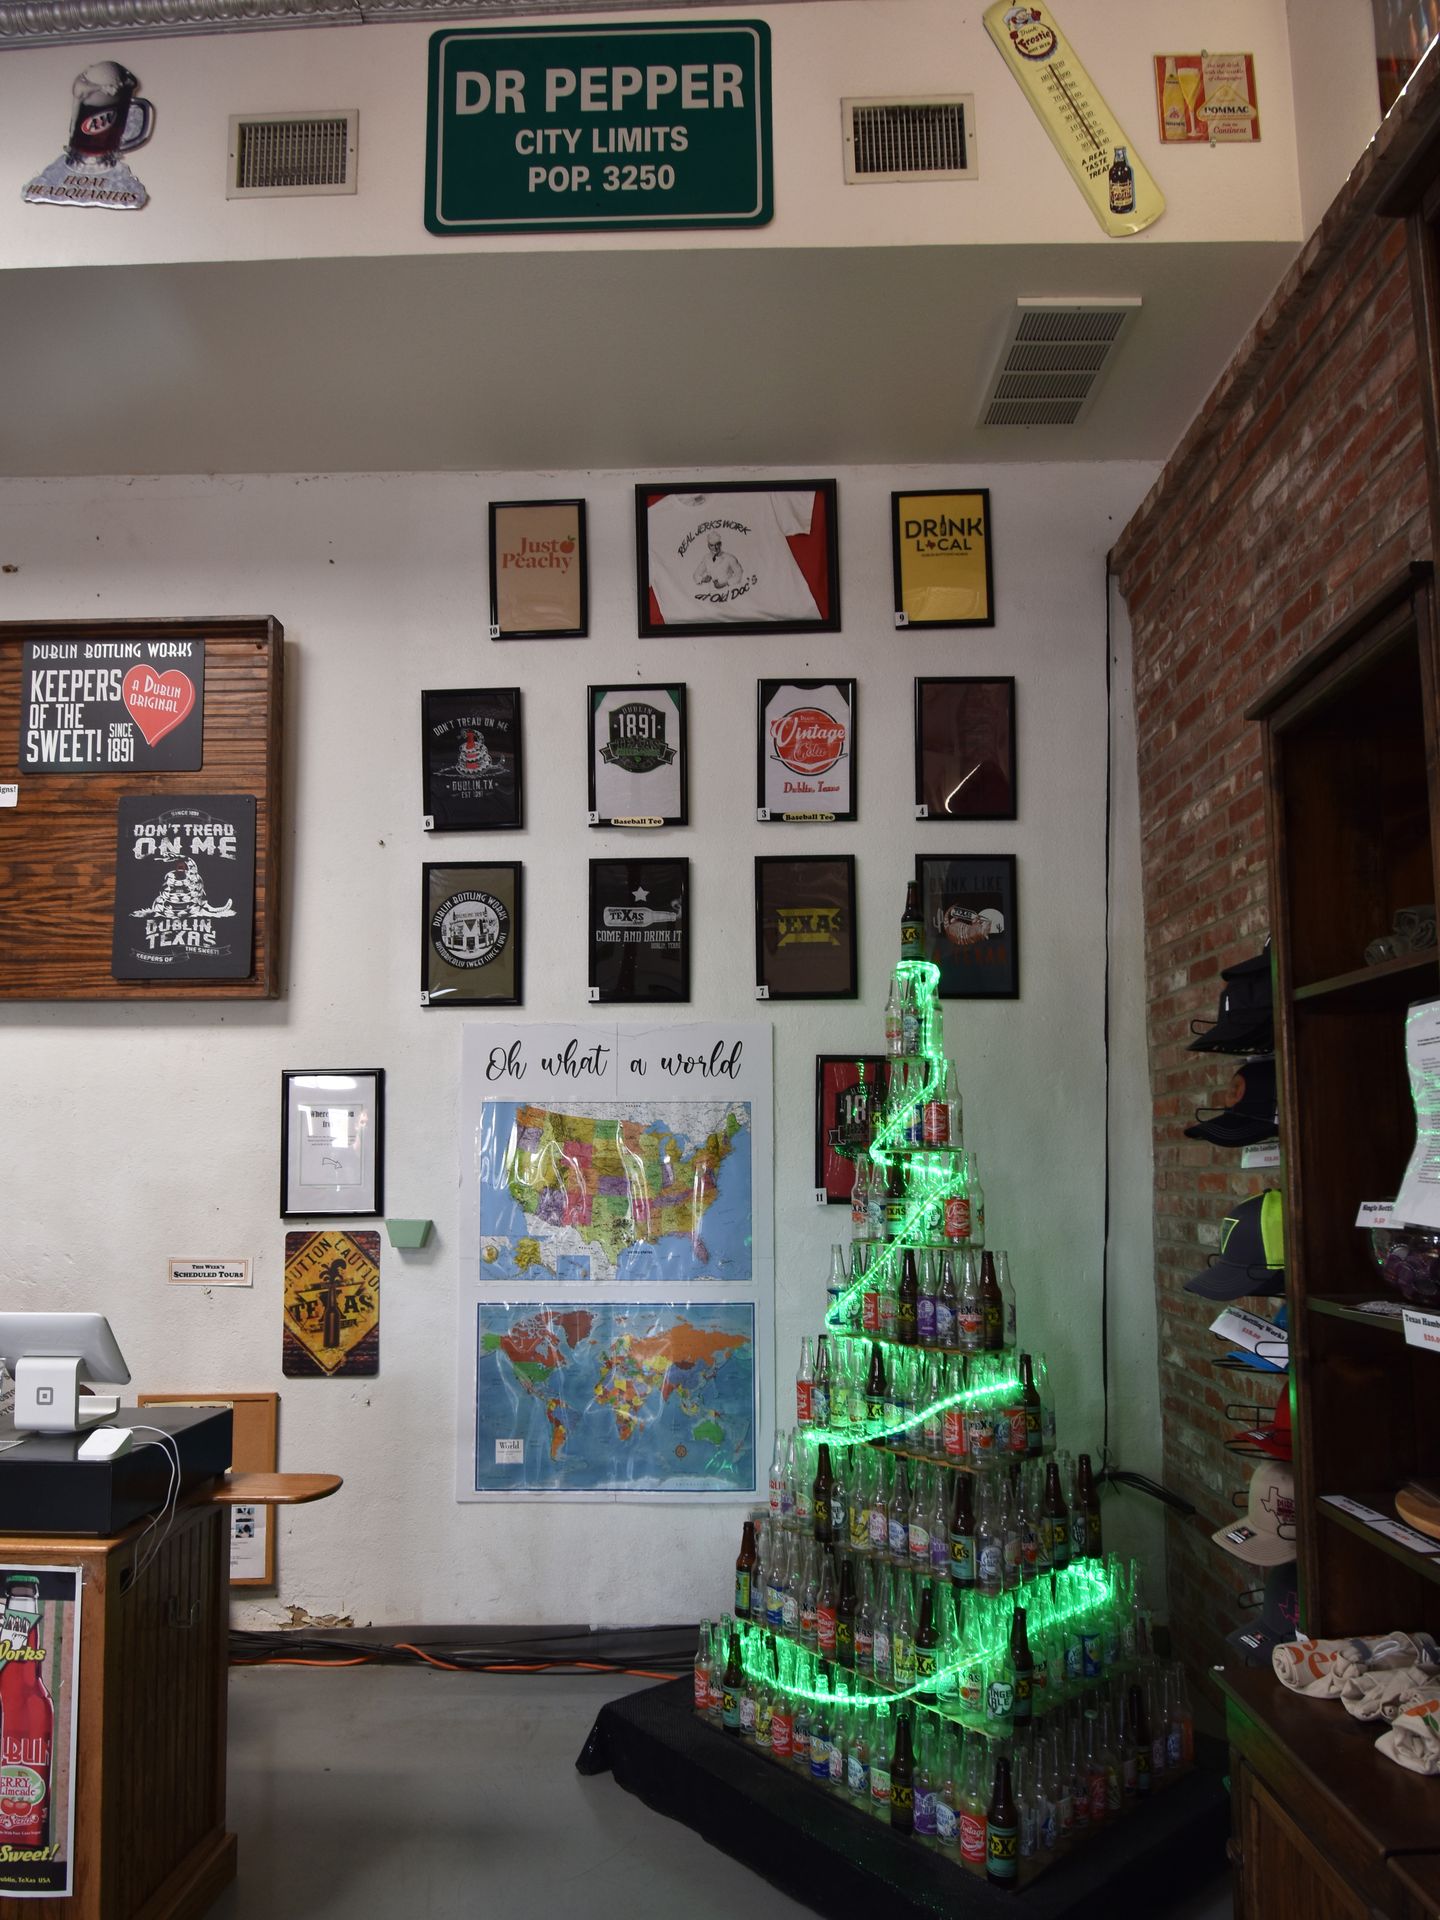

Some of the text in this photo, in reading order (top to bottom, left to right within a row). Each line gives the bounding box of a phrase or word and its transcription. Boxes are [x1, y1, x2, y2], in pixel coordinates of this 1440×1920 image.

[1017, 30, 1050, 50] Frostie
[456, 63, 744, 115] DR PEPPER
[1204, 106, 1249, 114] POMMAC
[515, 126, 689, 155] CITY LIMITS
[1085, 157, 1107, 173] TASTE
[1089, 149, 1107, 161] REAL
[63, 175, 108, 188] FLOAT
[528, 164, 676, 193] POP. 3250
[1089, 164, 1111, 180] TREAT
[27, 184, 138, 201] HEADQUARTERS
[520, 537, 559, 555] Just
[677, 531, 696, 558] REAL
[695, 519, 722, 536] JERKS
[502, 552, 573, 574] Peachy
[32, 642, 193, 660] DUBLIN BOTTLING WORKS
[30, 669, 123, 702] KEEPERS
[129, 694, 179, 714] ORIGINAL
[29, 703, 84, 729] OF THE
[619, 713, 656, 739] 1891
[109, 723, 133, 738] SINCE
[433, 719, 455, 737] DON'T
[484, 718, 495, 728] ON
[770, 716, 846, 748] Vintage
[26, 729, 102, 763] SWEET!
[107, 738, 134, 763] 1891
[589, 813, 595, 821] 2
[761, 809, 767, 818] 3
[785, 813, 818, 821] Baseball
[133, 823, 236, 837] DON'T TREAD
[132, 836, 237, 860] ON ME
[432, 891, 509, 927] DUBLIN BOTTLING WORKS
[609, 909, 644, 922] TEXAS
[145, 930, 217, 949] TEXAS
[596, 930, 682, 943] COME AND DRINK IT
[485, 1038, 743, 1081] Oh what a world
[289, 1289, 375, 1321] TEXAS
[0, 1843, 60, 1863] Sweet!
